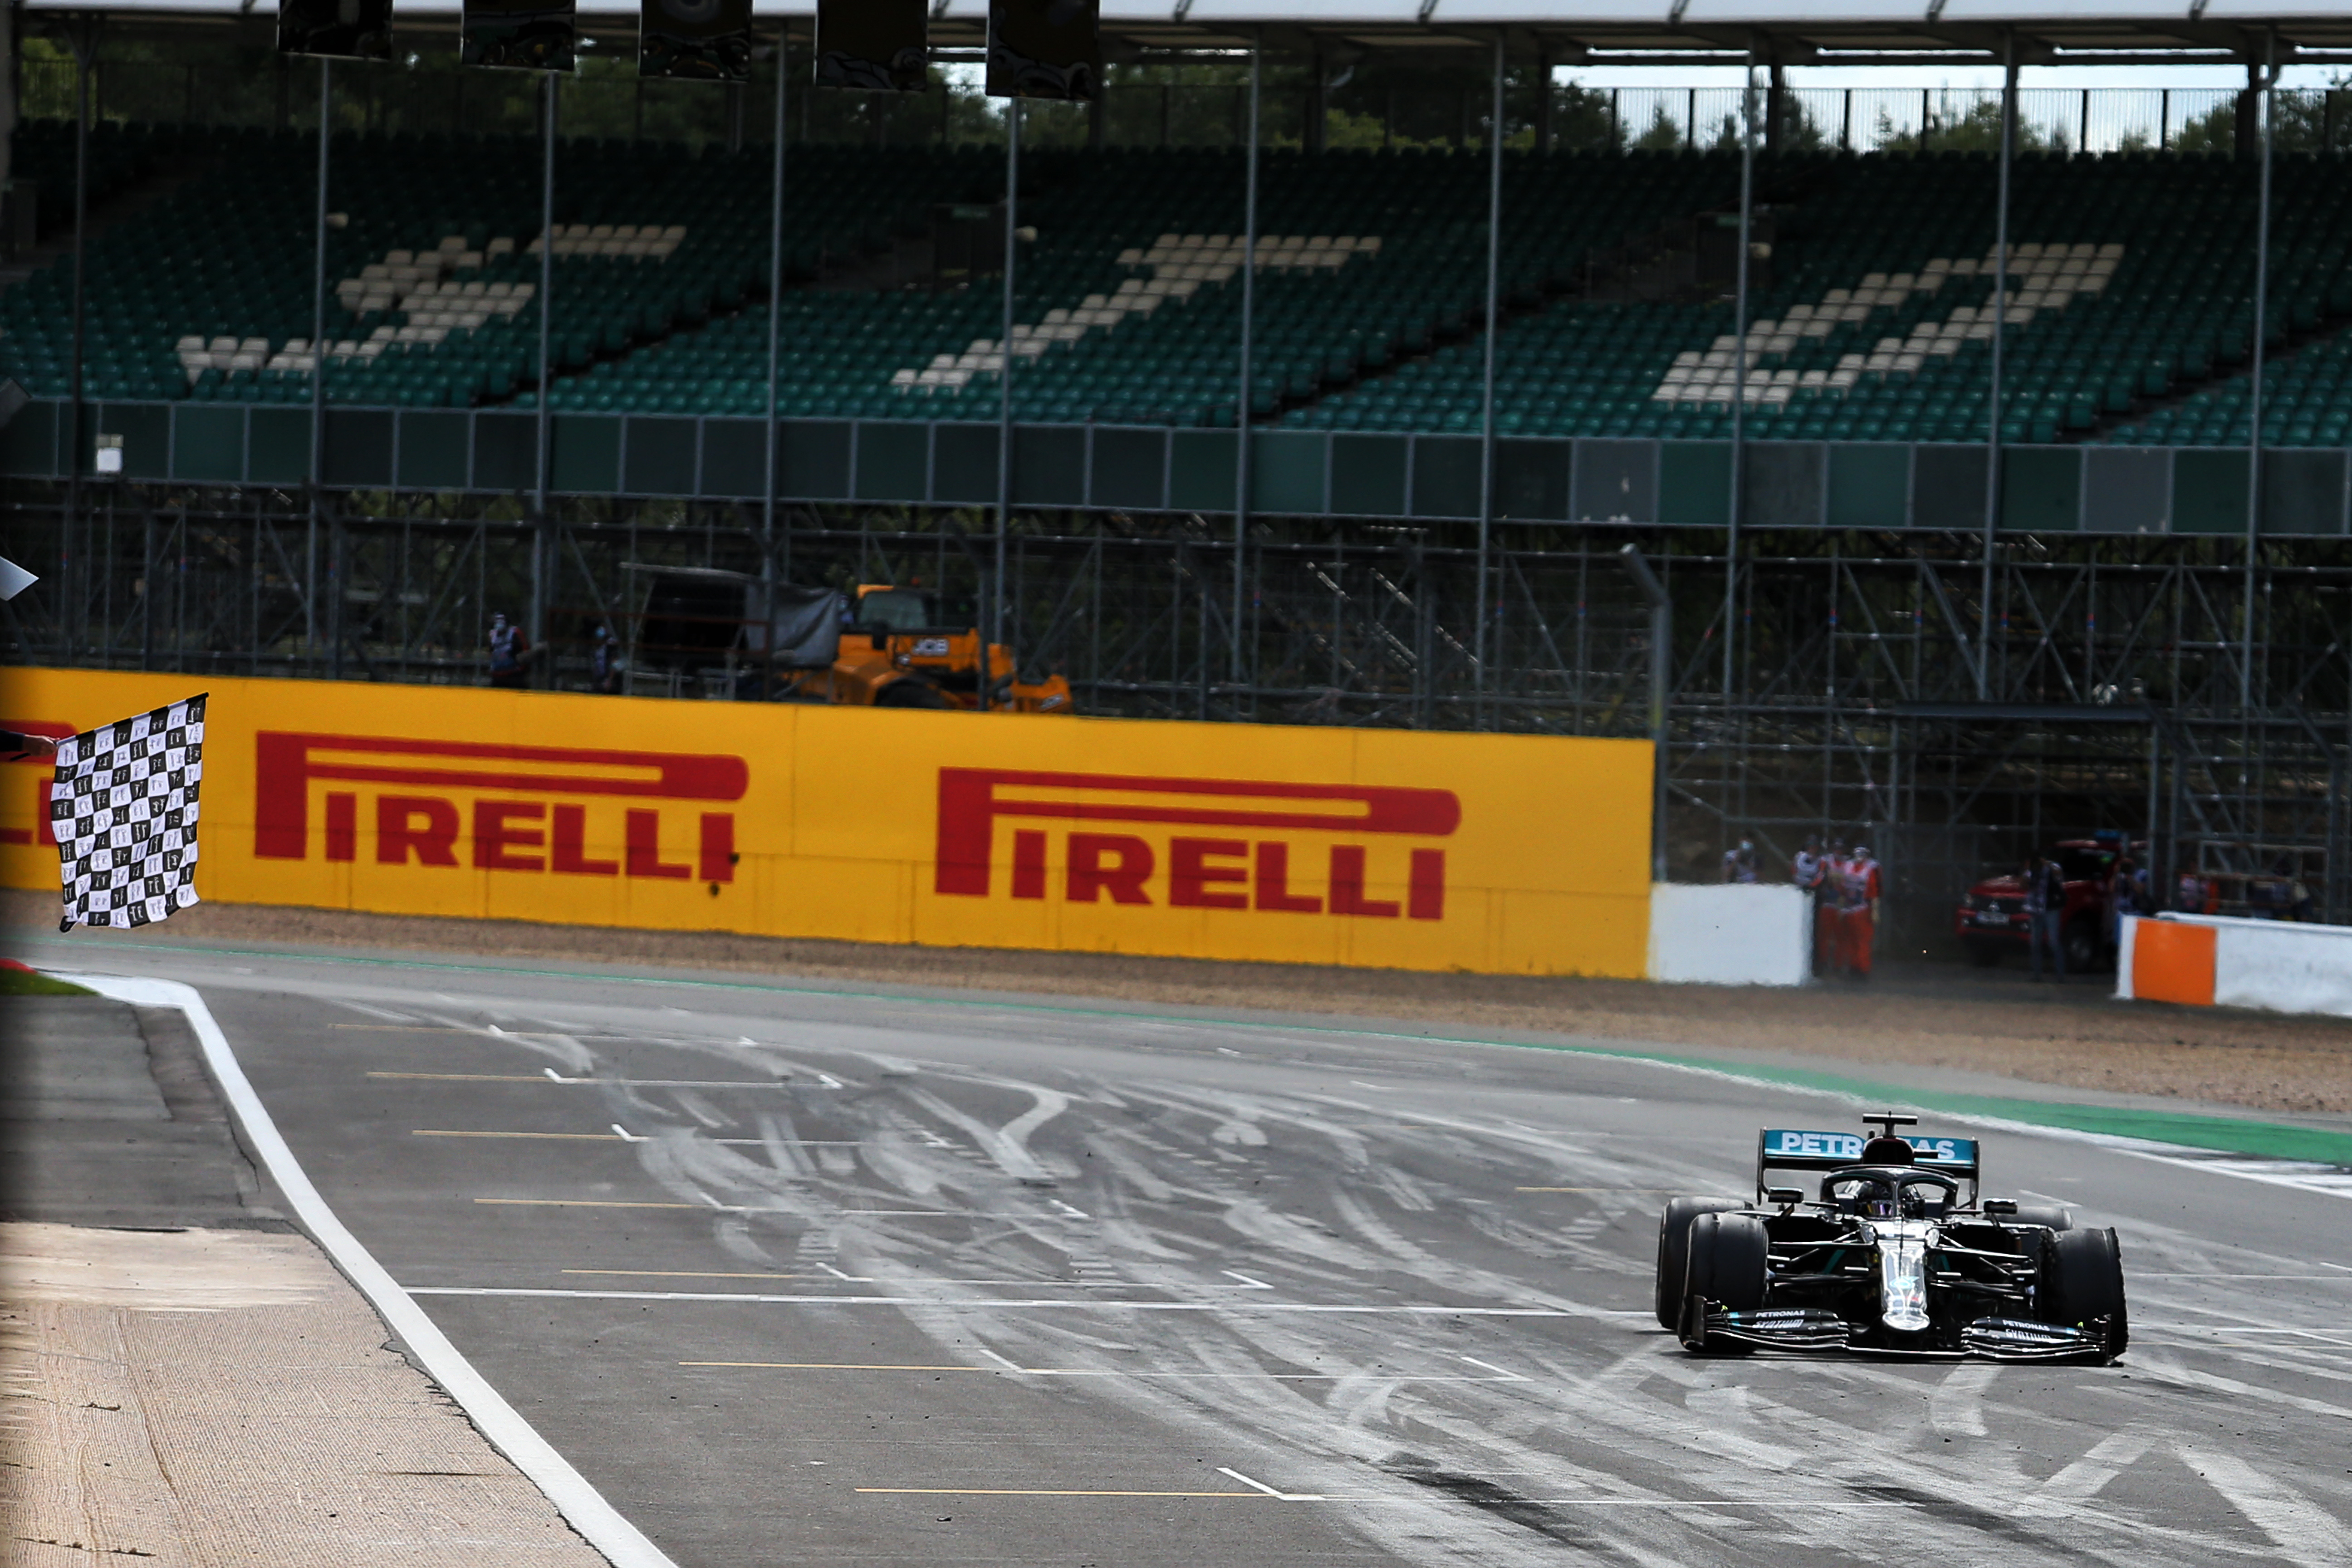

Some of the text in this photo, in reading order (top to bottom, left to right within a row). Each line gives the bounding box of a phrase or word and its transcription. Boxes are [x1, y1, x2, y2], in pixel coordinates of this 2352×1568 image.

[255, 730, 750, 883] PIRELLI
[935, 766, 1461, 920] PIRELLI
[1782, 1132, 1955, 1159] PETRAS
[2002, 1319, 2050, 1331] PETRONAS
